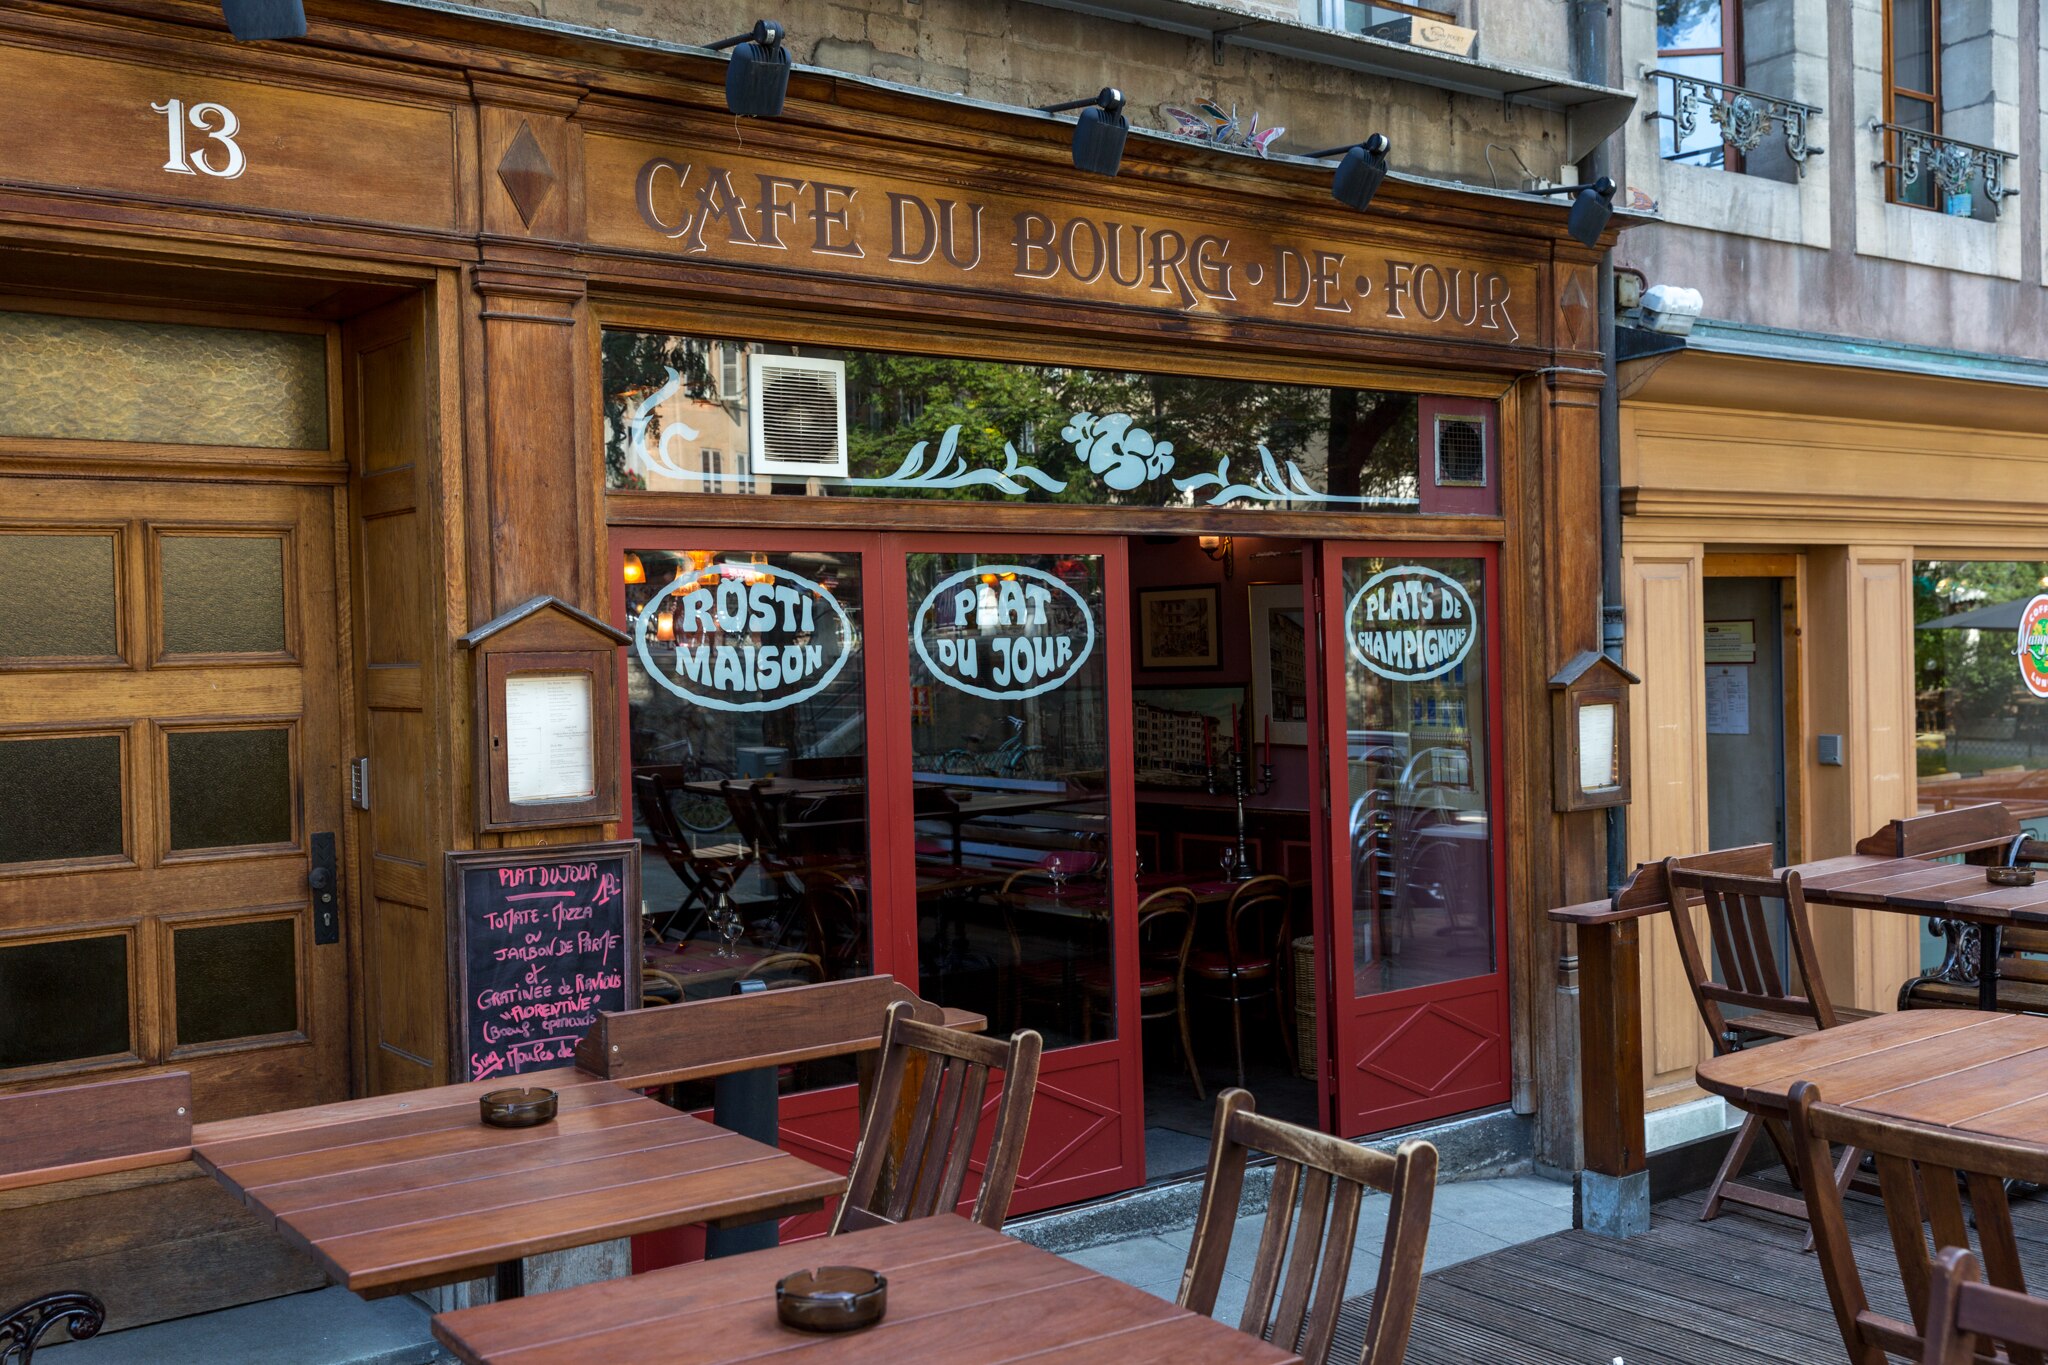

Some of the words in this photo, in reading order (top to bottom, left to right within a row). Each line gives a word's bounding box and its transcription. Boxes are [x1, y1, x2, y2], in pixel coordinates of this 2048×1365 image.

[151, 99, 247, 180] 13
[635, 157, 866, 259] CAFE
[885, 191, 984, 271] DU
[1011, 211, 1238, 311] BOURG
[1272, 244, 1352, 313] DE
[1384, 259, 1519, 344] FOUR
[682, 578, 815, 633] RÖSTI
[954, 580, 1051, 626] PLAT
[1365, 581, 1434, 621] PLATS
[1440, 587, 1463, 620] DE
[675, 645, 823, 692] MAISON
[937, 638, 978, 679] DU
[992, 636, 1073, 687] JOUR
[1358, 628, 1467, 669] CHAMPIGNONS
[499, 867, 537, 887] PLAT
[539, 866, 559, 887] DU
[558, 863, 598, 884] JOUR
[483, 908, 540, 934] TOMATE
[552, 901, 593, 931] MOZZA
[494, 936, 558, 961] JAMBON
[556, 940, 574, 957] DE
[577, 930, 621, 966] PARME
[525, 963, 546, 985] et
[558, 977, 574, 996] de
